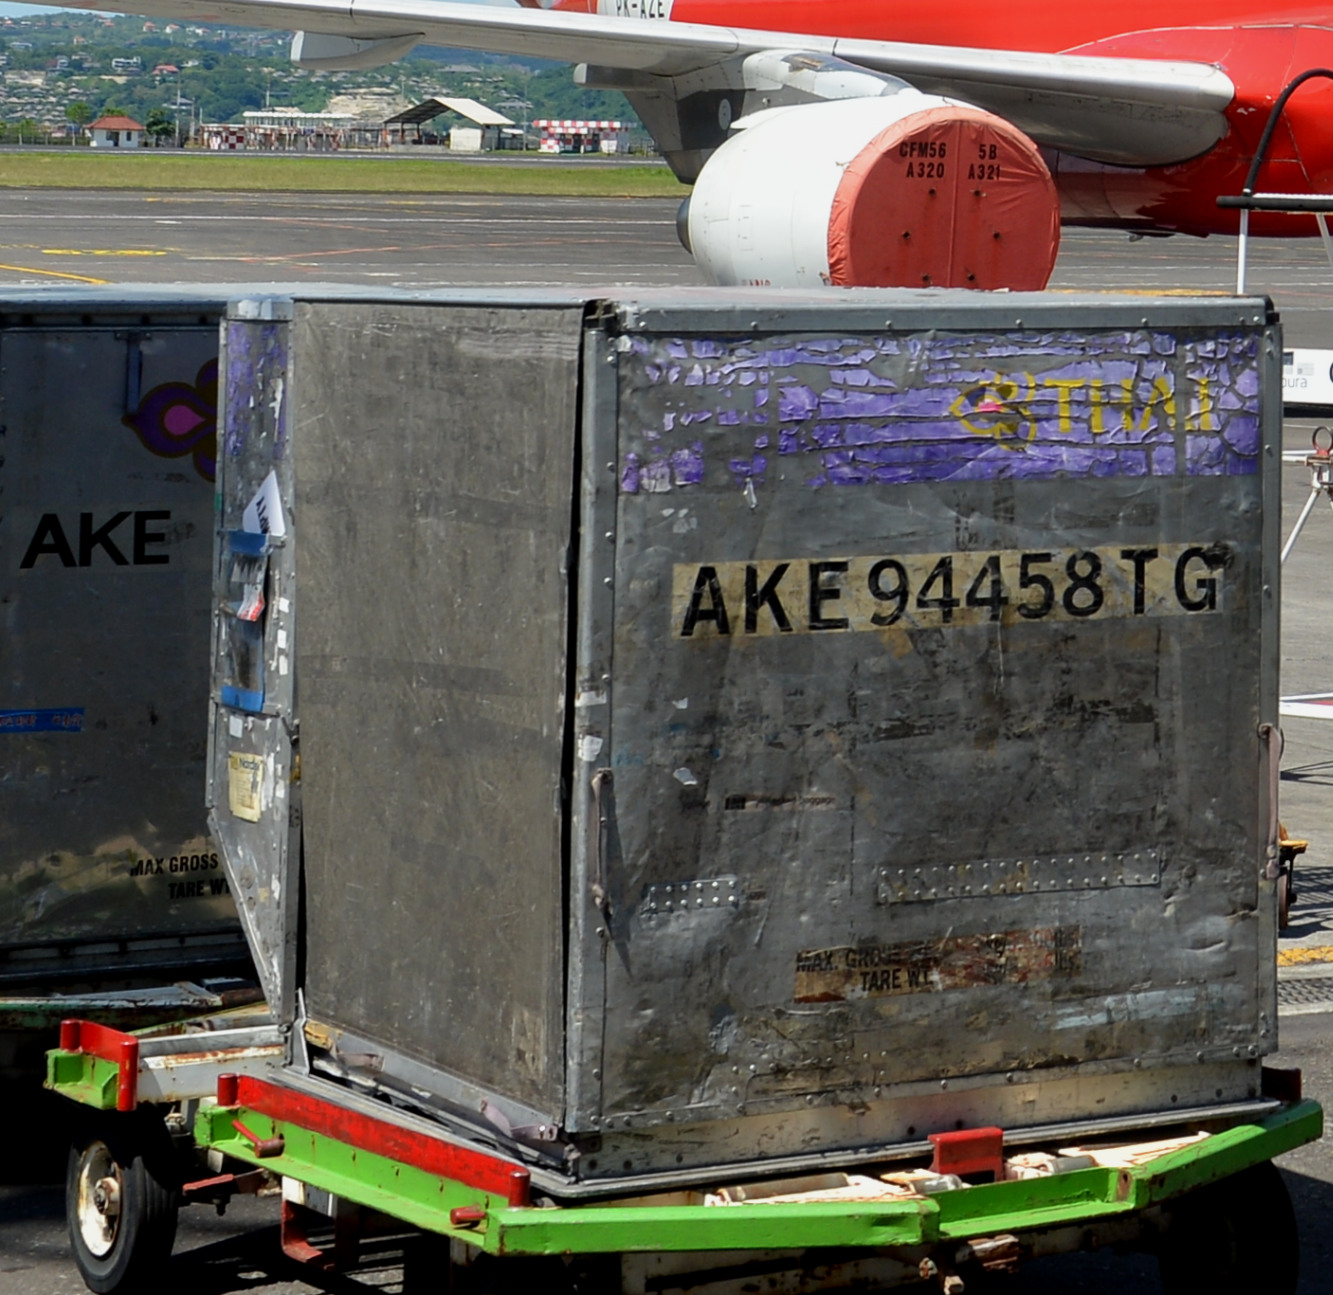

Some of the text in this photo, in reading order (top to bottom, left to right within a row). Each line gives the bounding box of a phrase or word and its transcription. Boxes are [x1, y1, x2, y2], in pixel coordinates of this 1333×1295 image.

[978, 143, 998, 161] 5B
[905, 161, 1001, 181] A320 A321
[1043, 376, 1216, 434] THAI
[18, 509, 172, 570] AKE
[168, 852, 219, 873] GROSS
[168, 879, 205, 900] TARE
[859, 967, 902, 993] TARE
